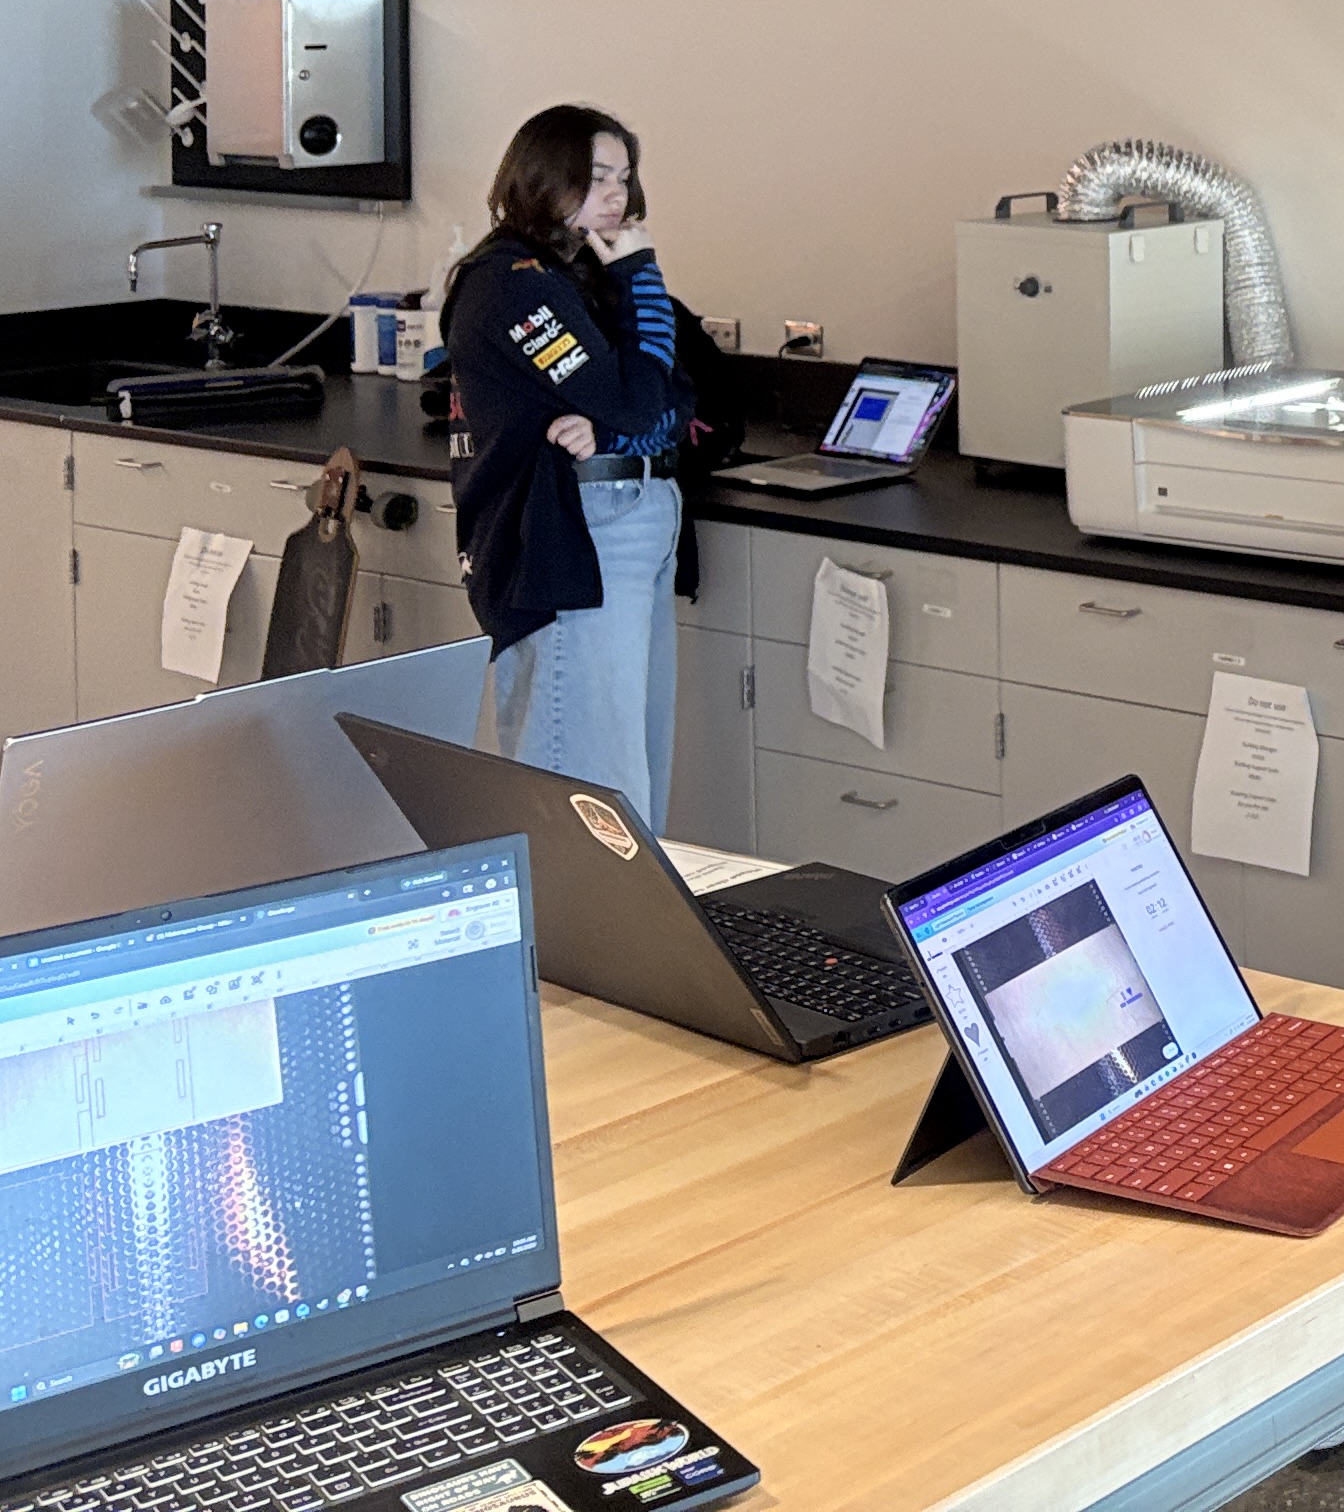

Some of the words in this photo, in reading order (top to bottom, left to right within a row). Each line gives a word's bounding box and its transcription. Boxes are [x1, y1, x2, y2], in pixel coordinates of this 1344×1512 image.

[508, 305, 555, 343] Mobil
[548, 345, 590, 385] HRC
[143, 1348, 257, 1397] GIGABYTE
